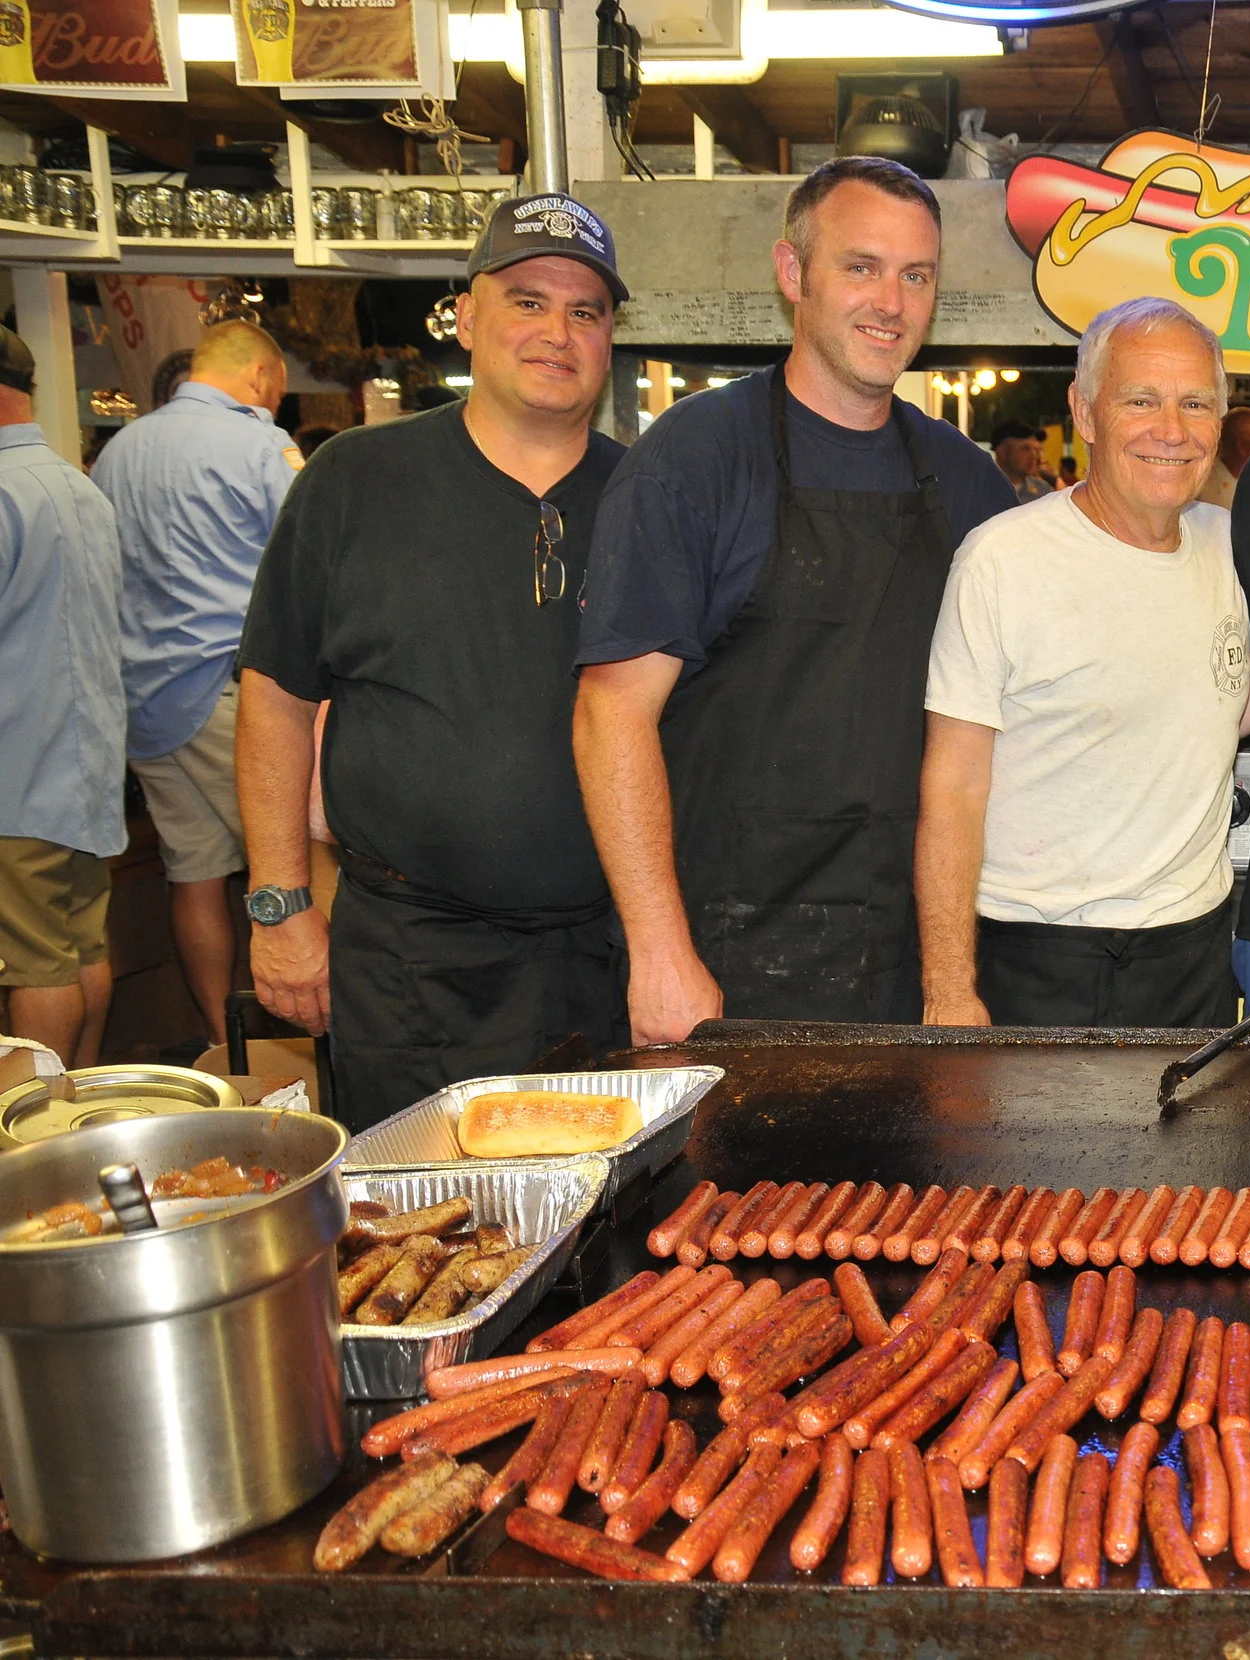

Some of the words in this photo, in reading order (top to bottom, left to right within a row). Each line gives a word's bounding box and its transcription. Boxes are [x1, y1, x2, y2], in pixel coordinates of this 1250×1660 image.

[31, 12, 158, 69] Bud
[513, 198, 589, 220] GREENLAWN
[514, 222, 545, 234] NEW
